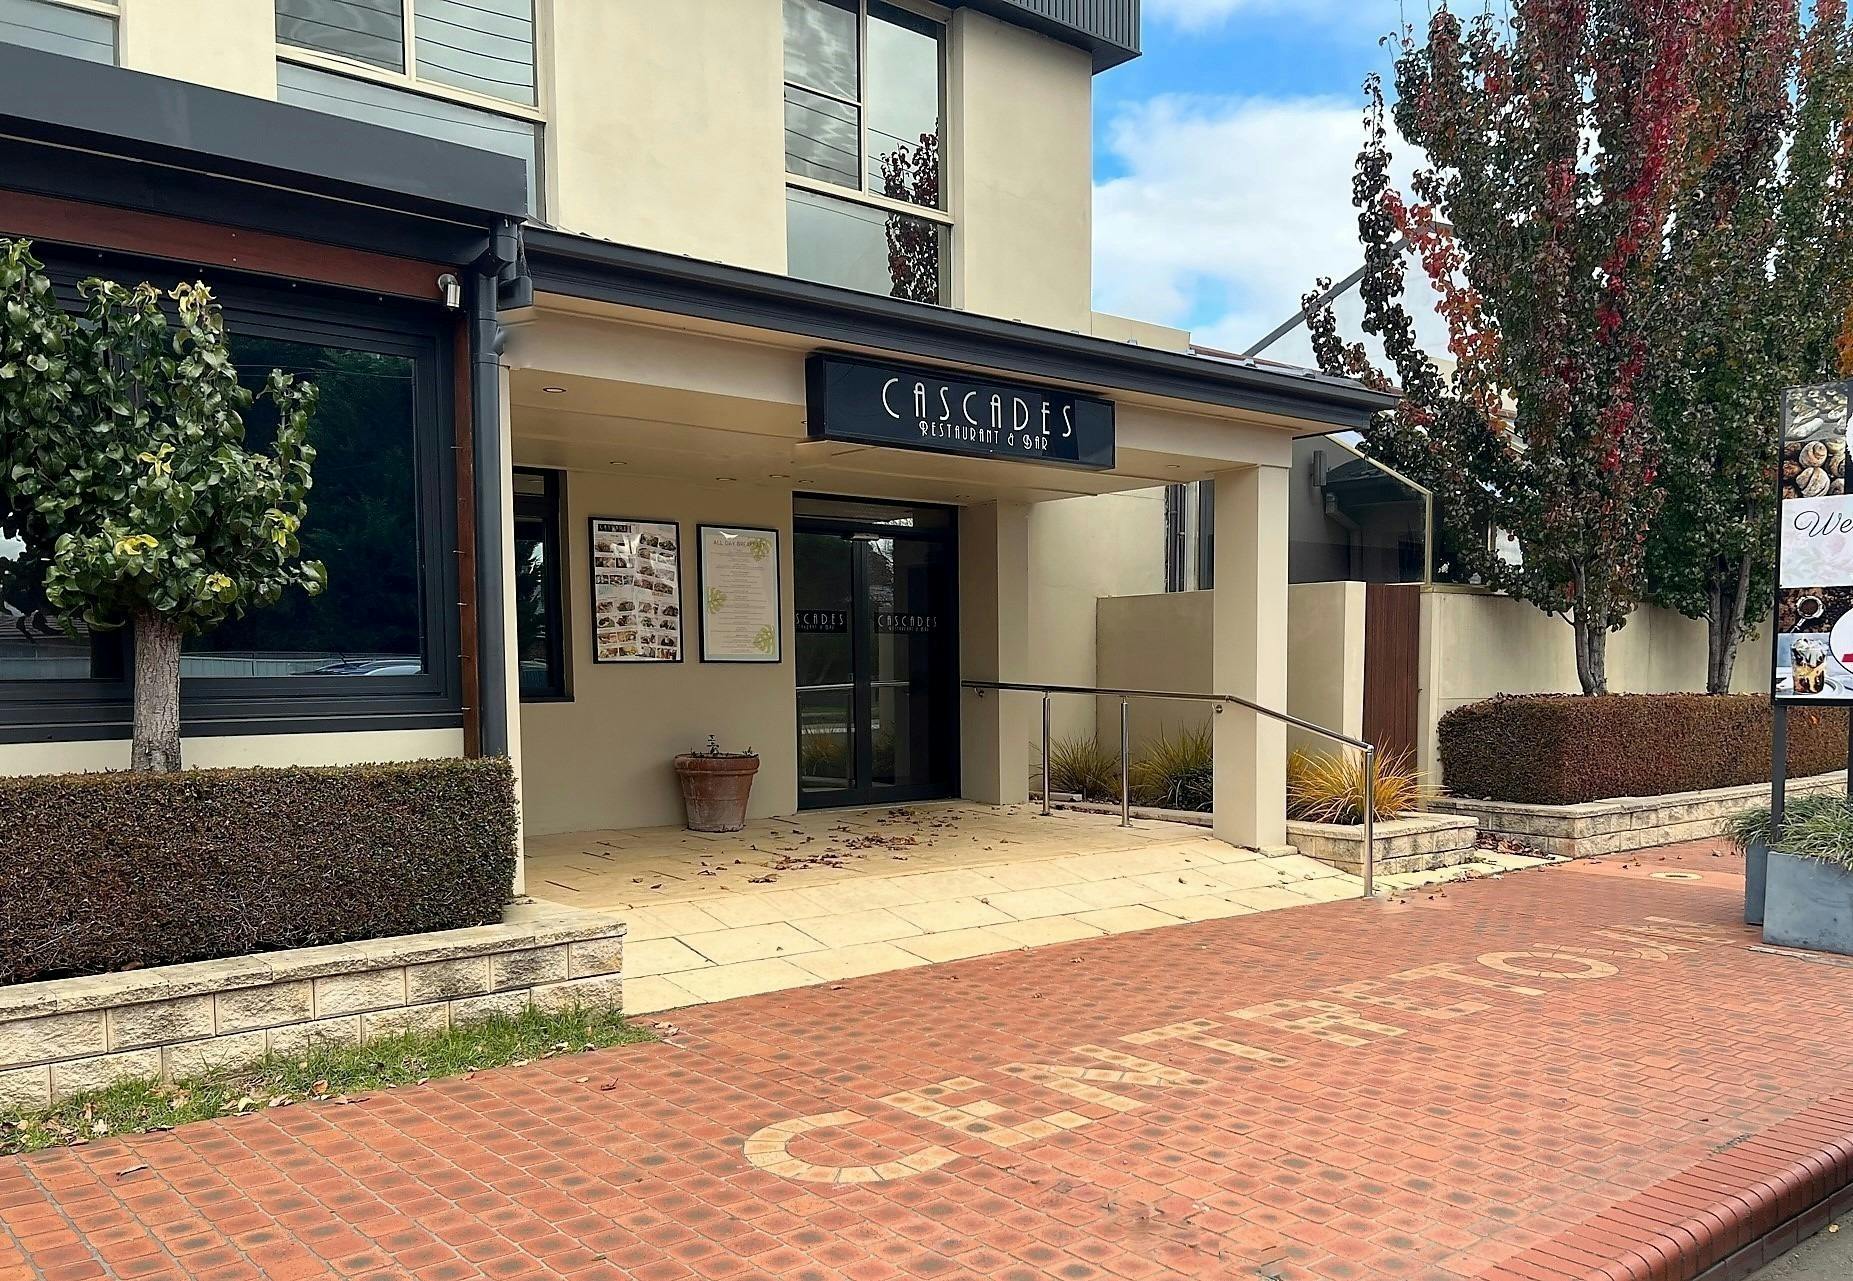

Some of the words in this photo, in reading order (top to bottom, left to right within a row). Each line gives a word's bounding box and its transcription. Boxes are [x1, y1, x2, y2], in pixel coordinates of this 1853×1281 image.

[882, 377, 1072, 438] CASCADES
[918, 420, 1000, 445] RESTAURANT
[1007, 431, 1015, 447] &
[1023, 434, 1049, 451] BAR
[877, 614, 938, 630] CASCADES
